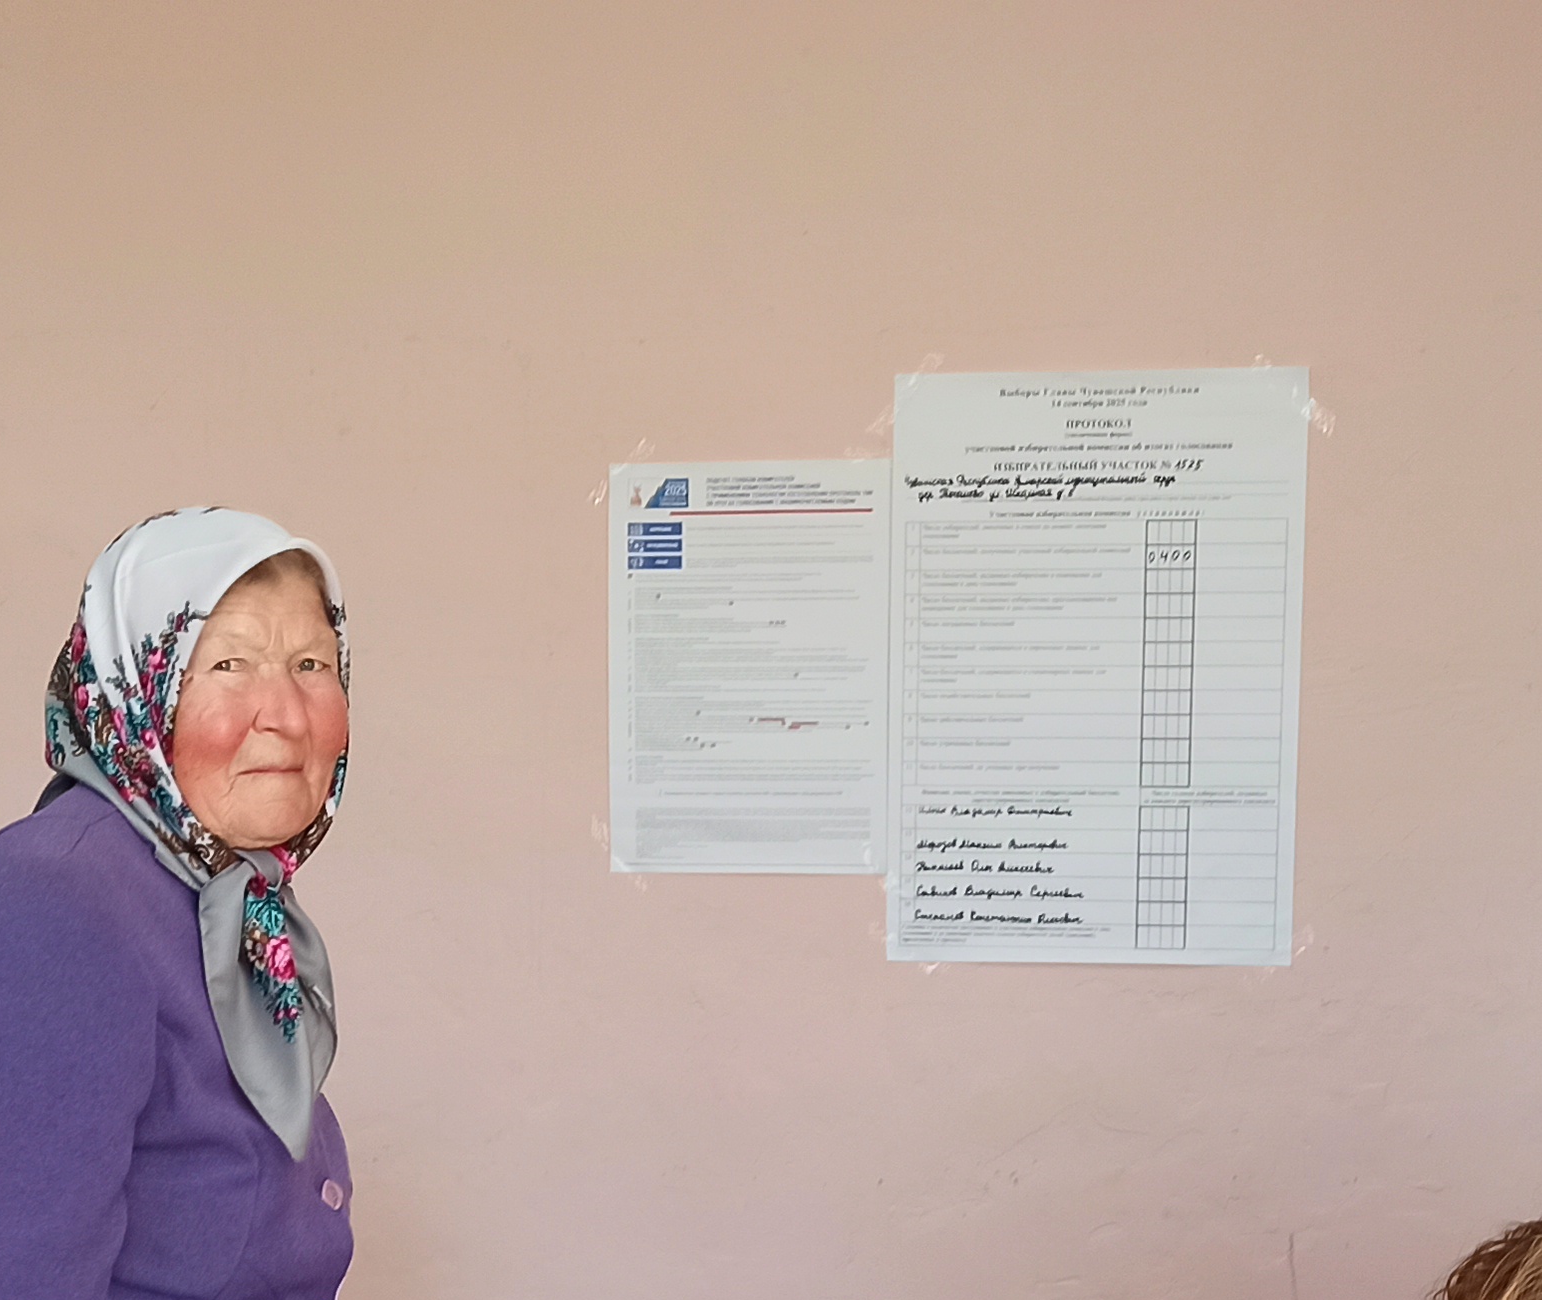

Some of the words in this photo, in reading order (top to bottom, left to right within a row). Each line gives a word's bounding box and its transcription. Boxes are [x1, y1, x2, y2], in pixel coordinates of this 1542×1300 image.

[1065, 419, 1132, 429] ПРОТОКОЛ
[993, 459, 1098, 472] ИЗБИРАТЕЛЬНЫЙ
[1100, 460, 1157, 472] УЧАСТОК
